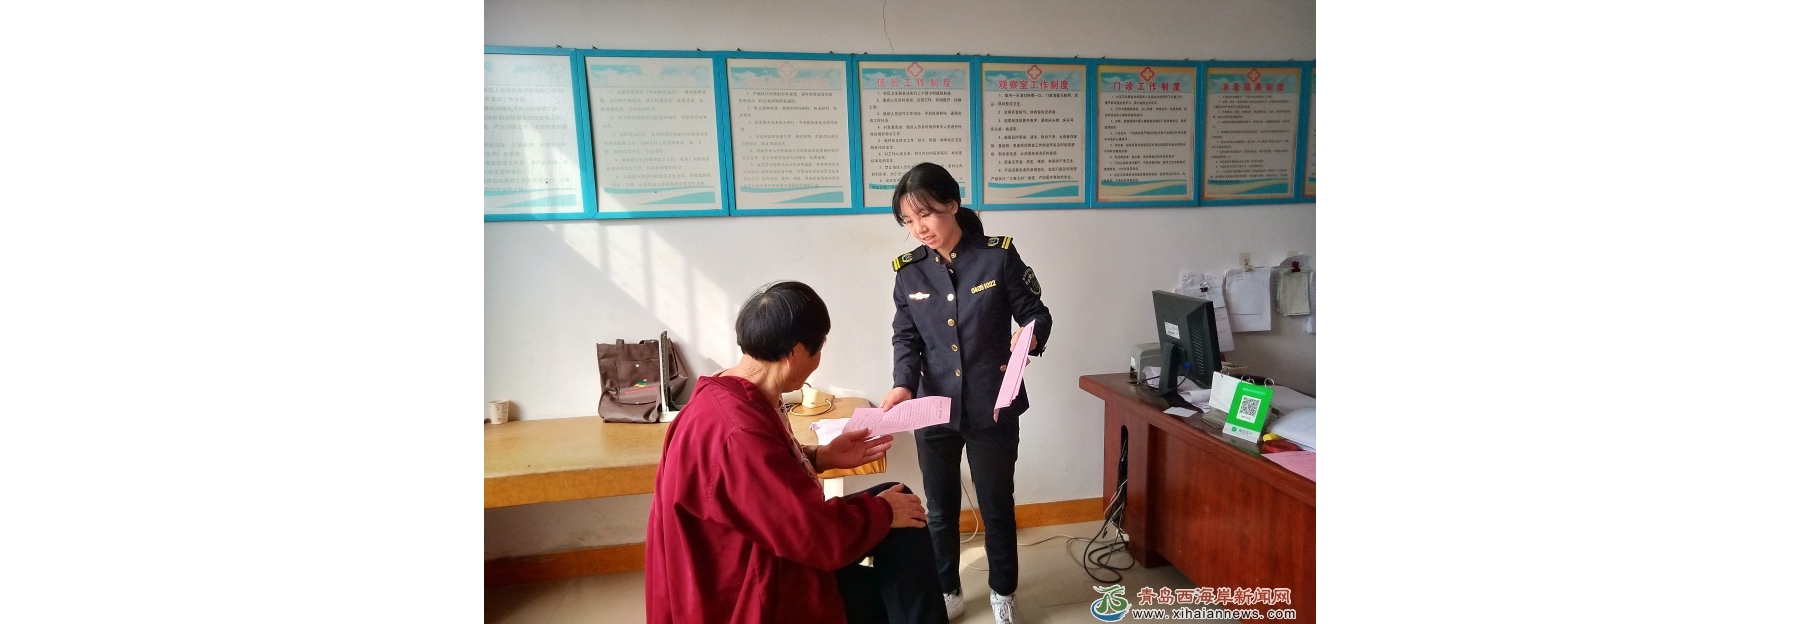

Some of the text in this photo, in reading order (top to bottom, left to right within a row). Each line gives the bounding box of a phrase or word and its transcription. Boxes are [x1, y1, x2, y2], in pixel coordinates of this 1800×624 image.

[998, 80, 1069, 90] 观察室工作制度
[1113, 81, 1181, 92] 门诊工作制度
[1221, 83, 1285, 92] 消毒隔离制度
